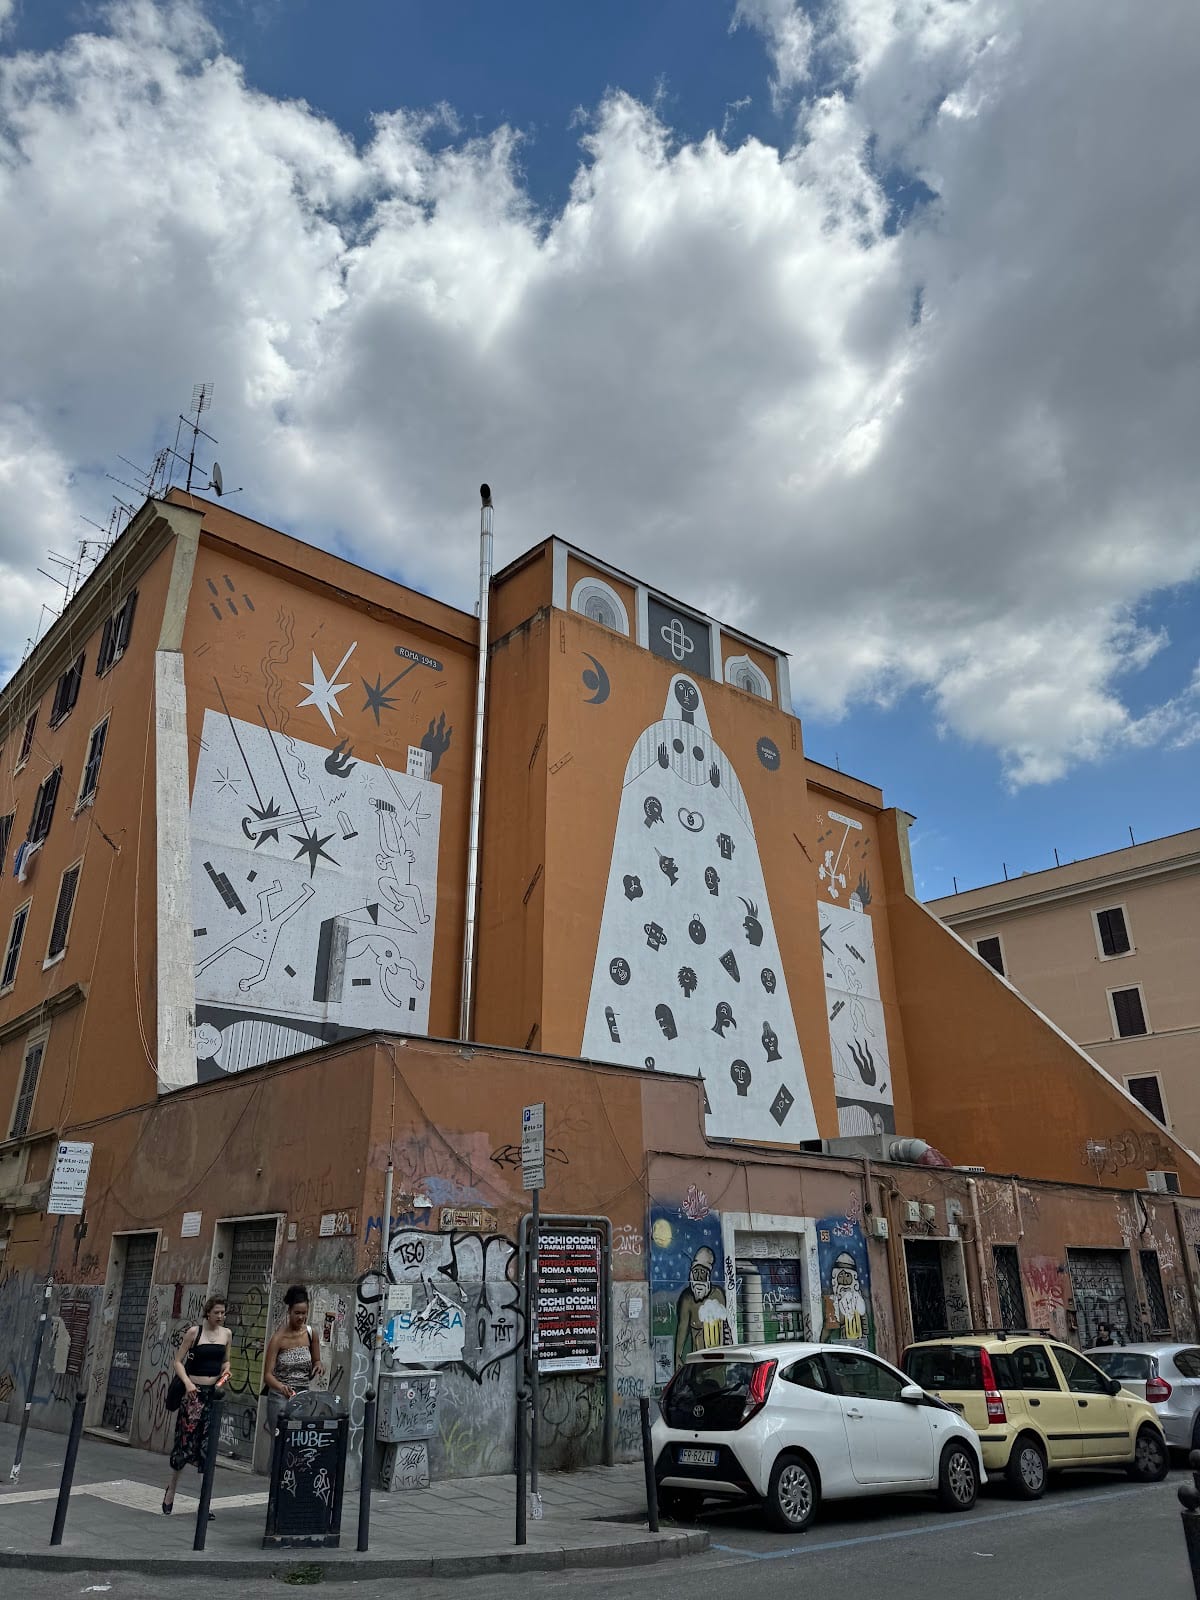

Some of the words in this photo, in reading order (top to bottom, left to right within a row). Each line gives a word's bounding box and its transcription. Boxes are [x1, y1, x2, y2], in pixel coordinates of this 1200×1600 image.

[399, 647, 419, 661] ROMA
[421, 656, 437, 668] 1943
[566, 1236, 596, 1244] OCCHI
[566, 1296, 596, 1304] OCCHI
